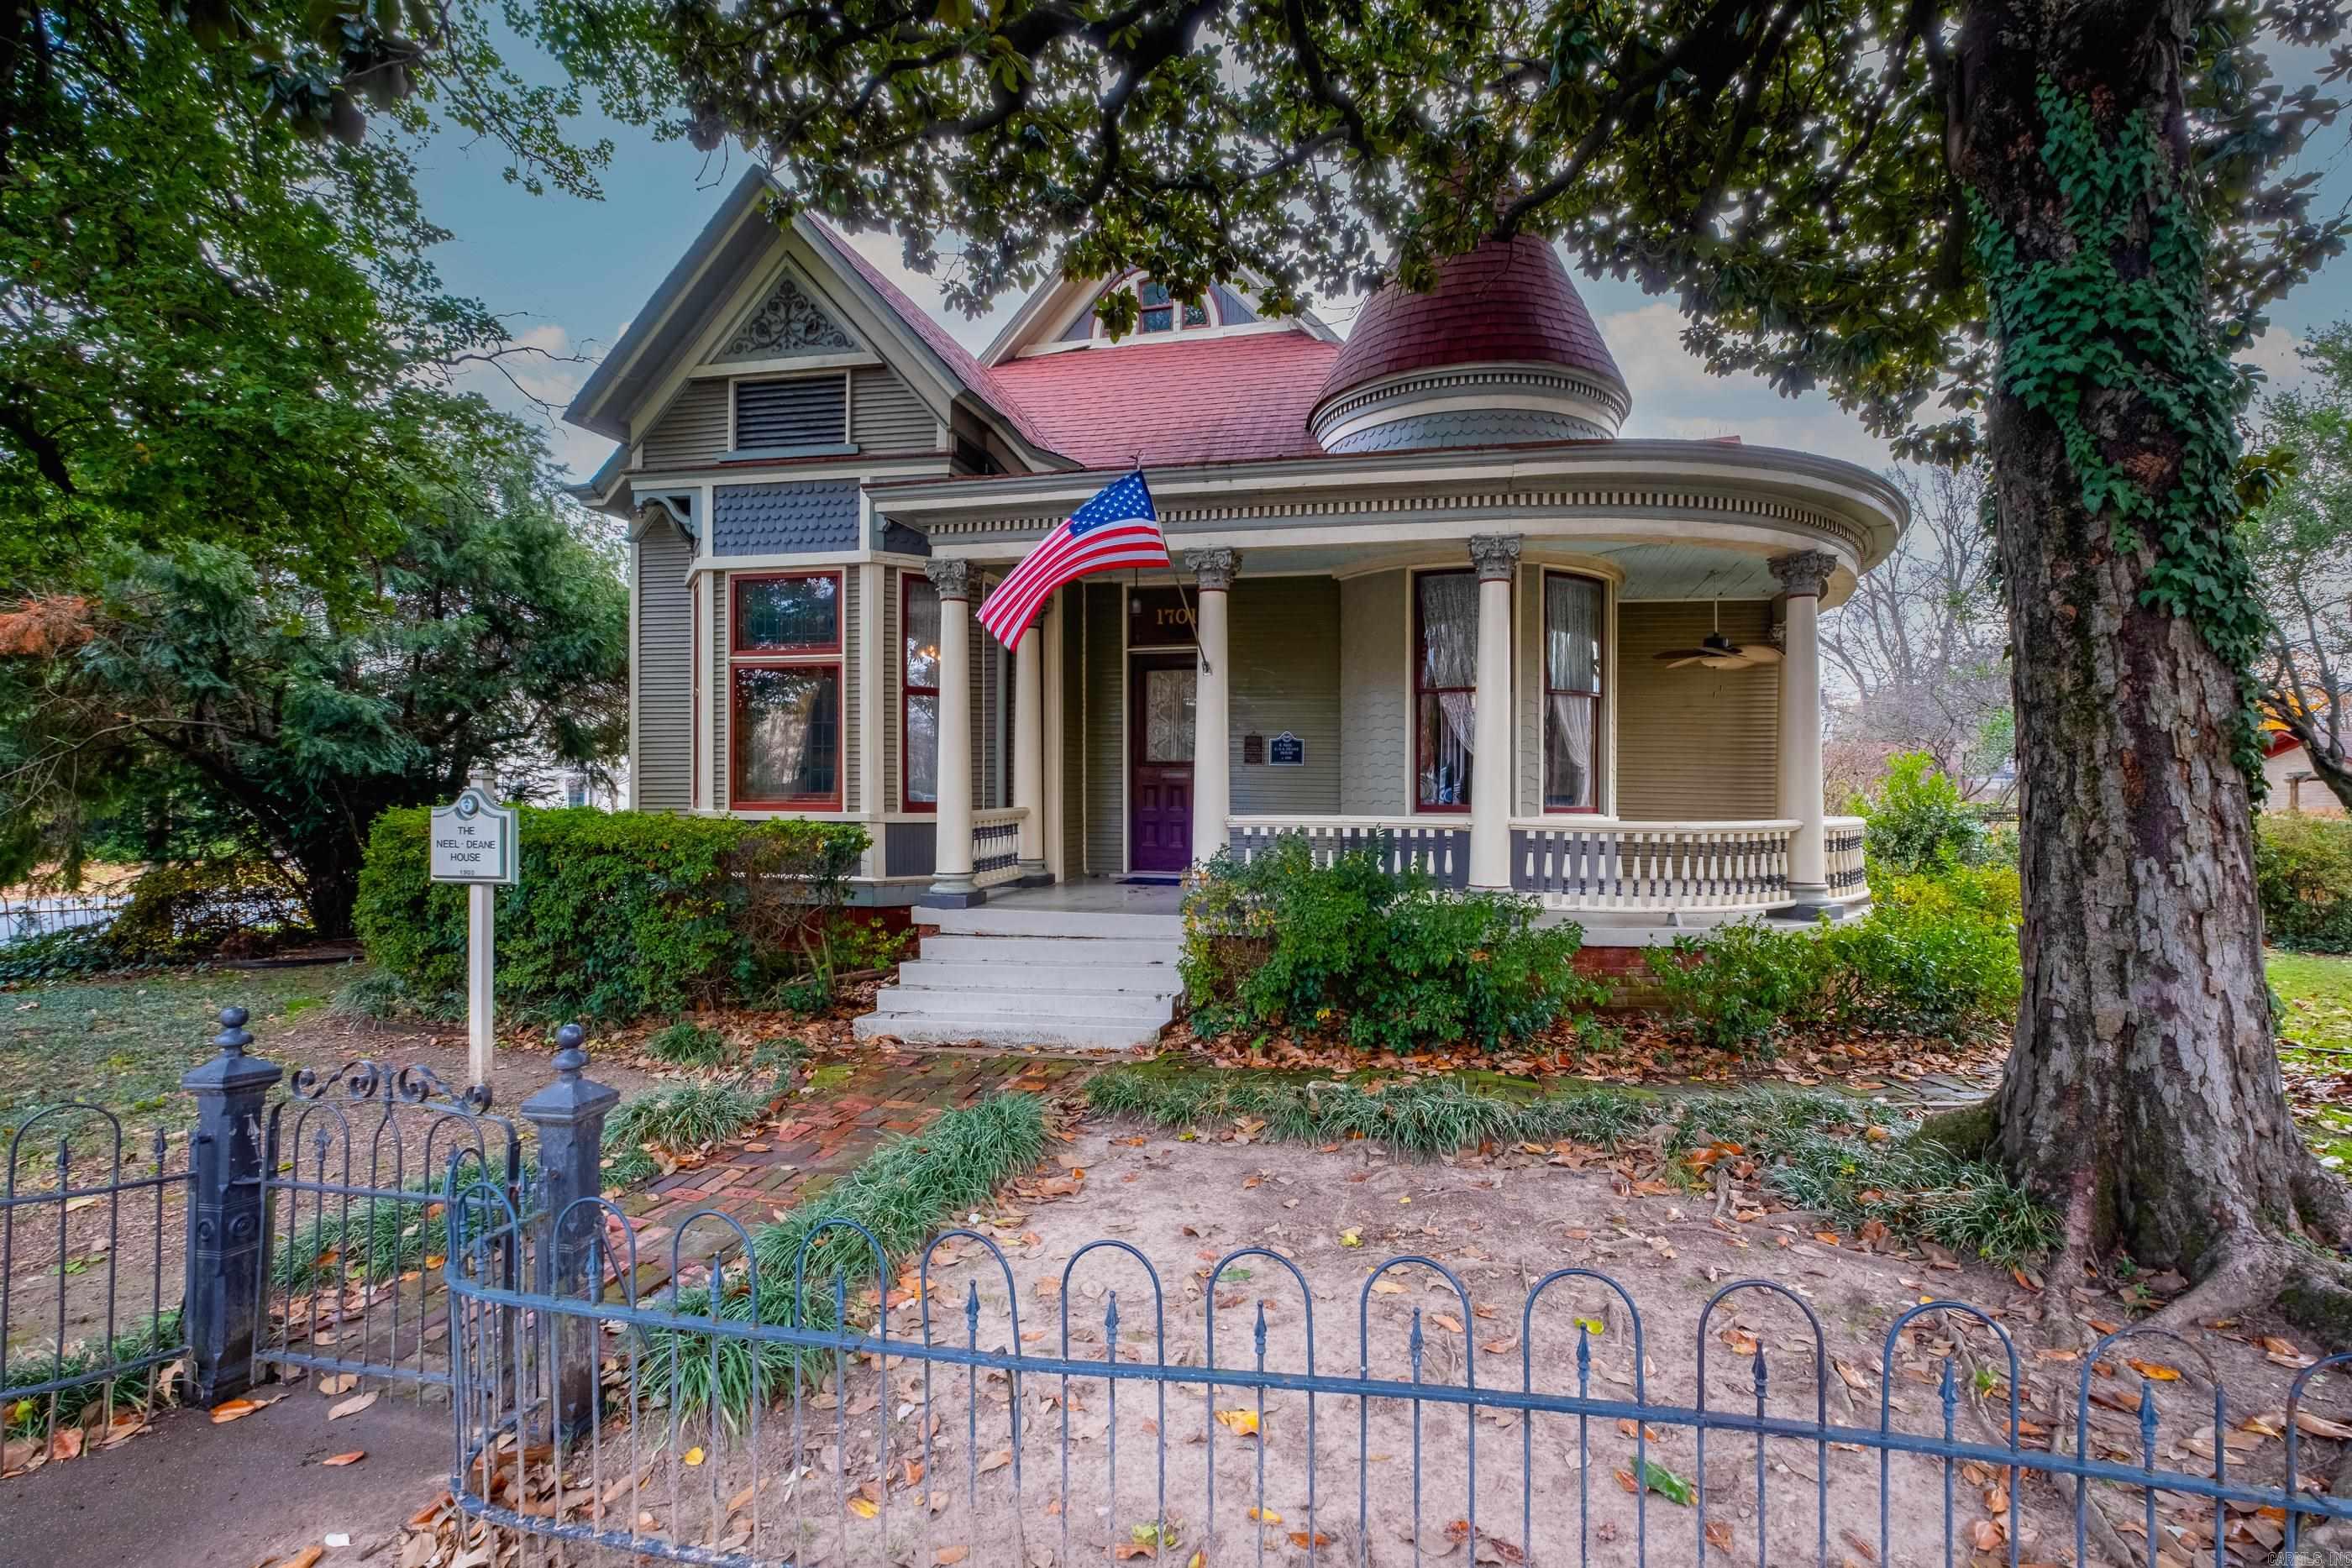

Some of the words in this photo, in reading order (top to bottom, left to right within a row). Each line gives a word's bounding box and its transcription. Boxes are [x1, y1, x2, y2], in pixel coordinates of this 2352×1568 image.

[1157, 608, 1197, 625] 1701
[458, 826, 475, 835] THE
[466, 841, 496, 849] DEANE
[450, 853, 481, 862] HOUSE
